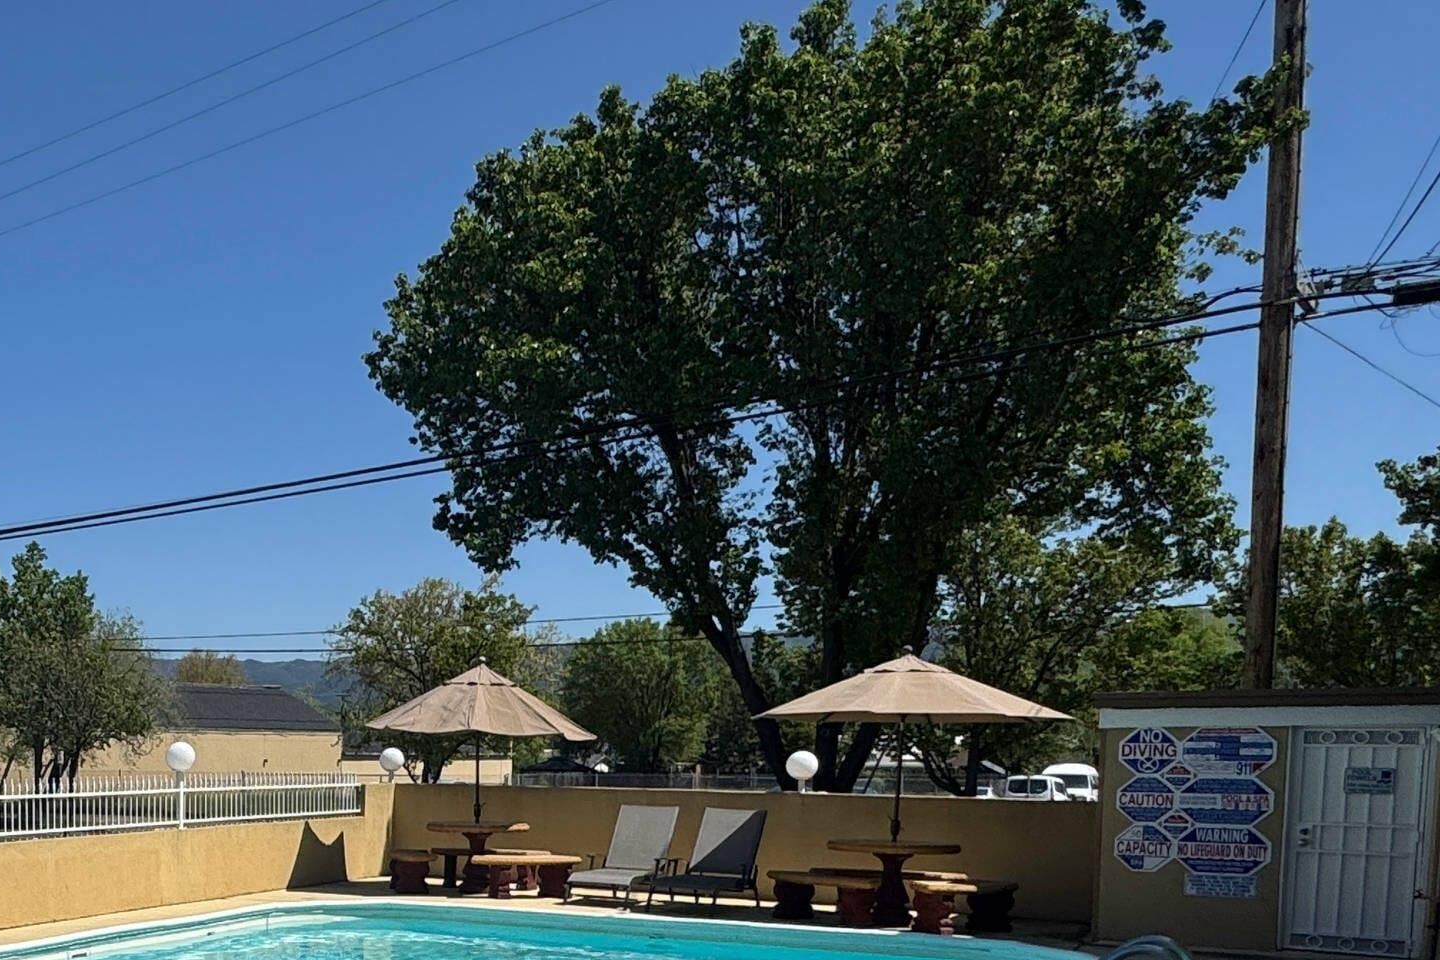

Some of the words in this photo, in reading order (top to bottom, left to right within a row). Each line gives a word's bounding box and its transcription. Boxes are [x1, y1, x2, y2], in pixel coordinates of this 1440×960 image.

[1140, 729, 1162, 743] NO
[1121, 743, 1177, 758] DIVING
[1236, 760, 1252, 775] 911
[1119, 793, 1173, 807] CAUTION
[1195, 828, 1249, 843] WARNING
[1116, 841, 1172, 857] CAPACITY
[1177, 844, 1188, 857] NO
[1190, 844, 1232, 858] LIFEGUARD
[1233, 845, 1245, 858] ON
[1247, 846, 1268, 861] DUTY
